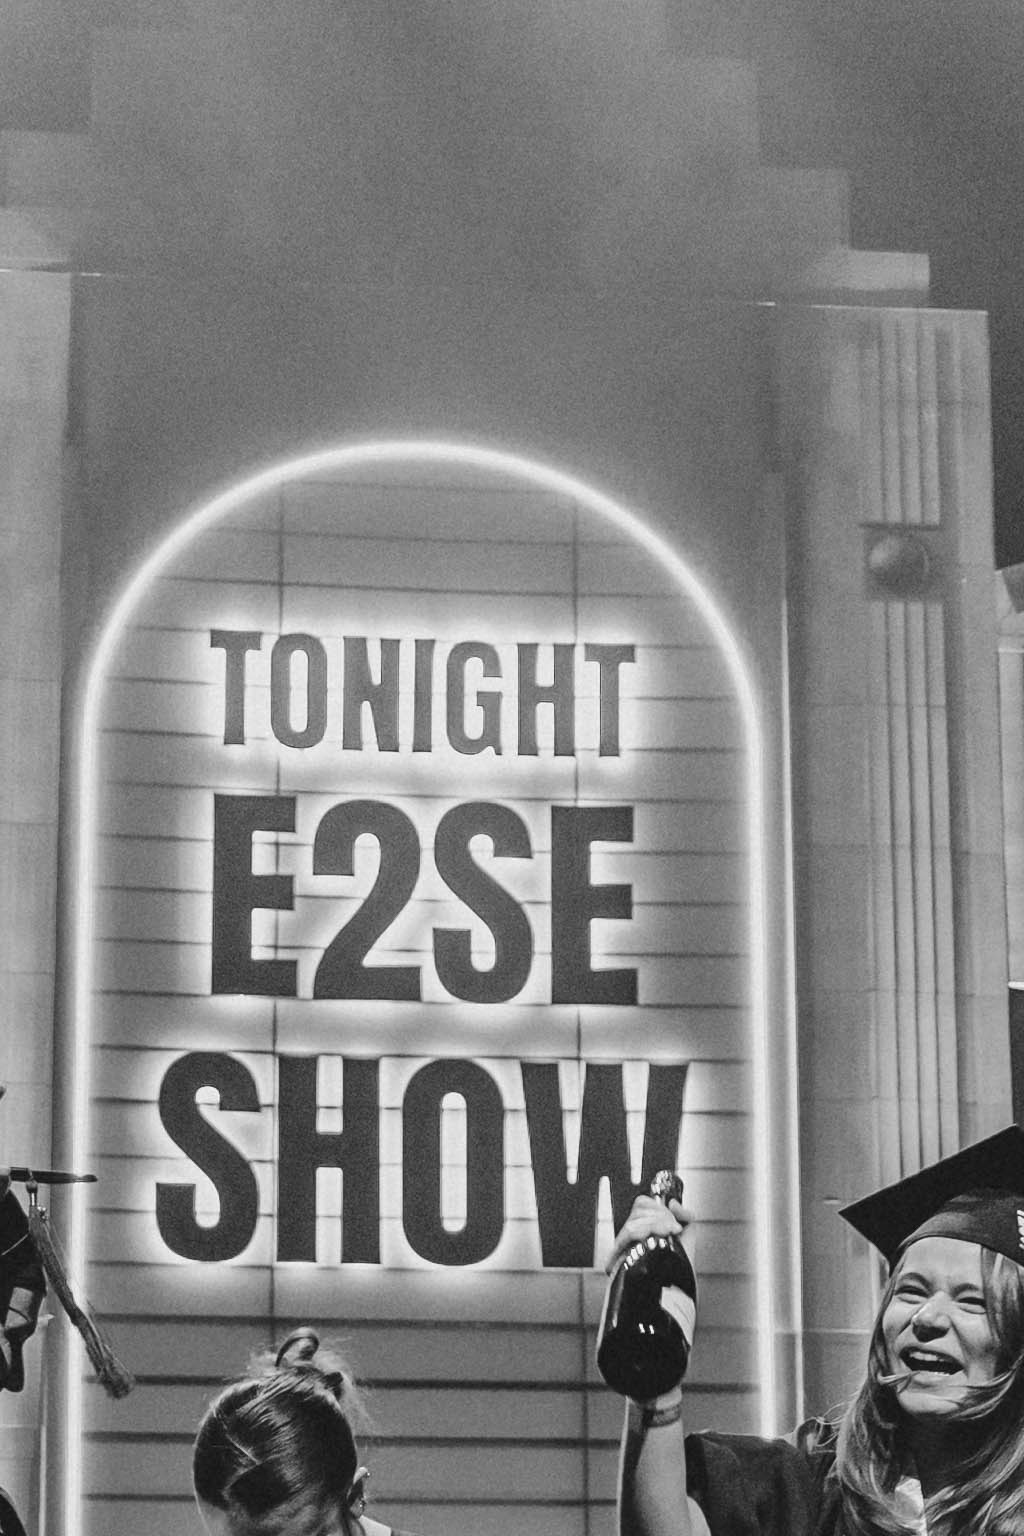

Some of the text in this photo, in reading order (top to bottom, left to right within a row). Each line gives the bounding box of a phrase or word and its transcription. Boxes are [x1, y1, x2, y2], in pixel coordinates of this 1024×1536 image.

[210, 629, 636, 757] TONIGHT
[211, 793, 638, 1005] E2SE
[155, 1050, 691, 1267] SHOW
